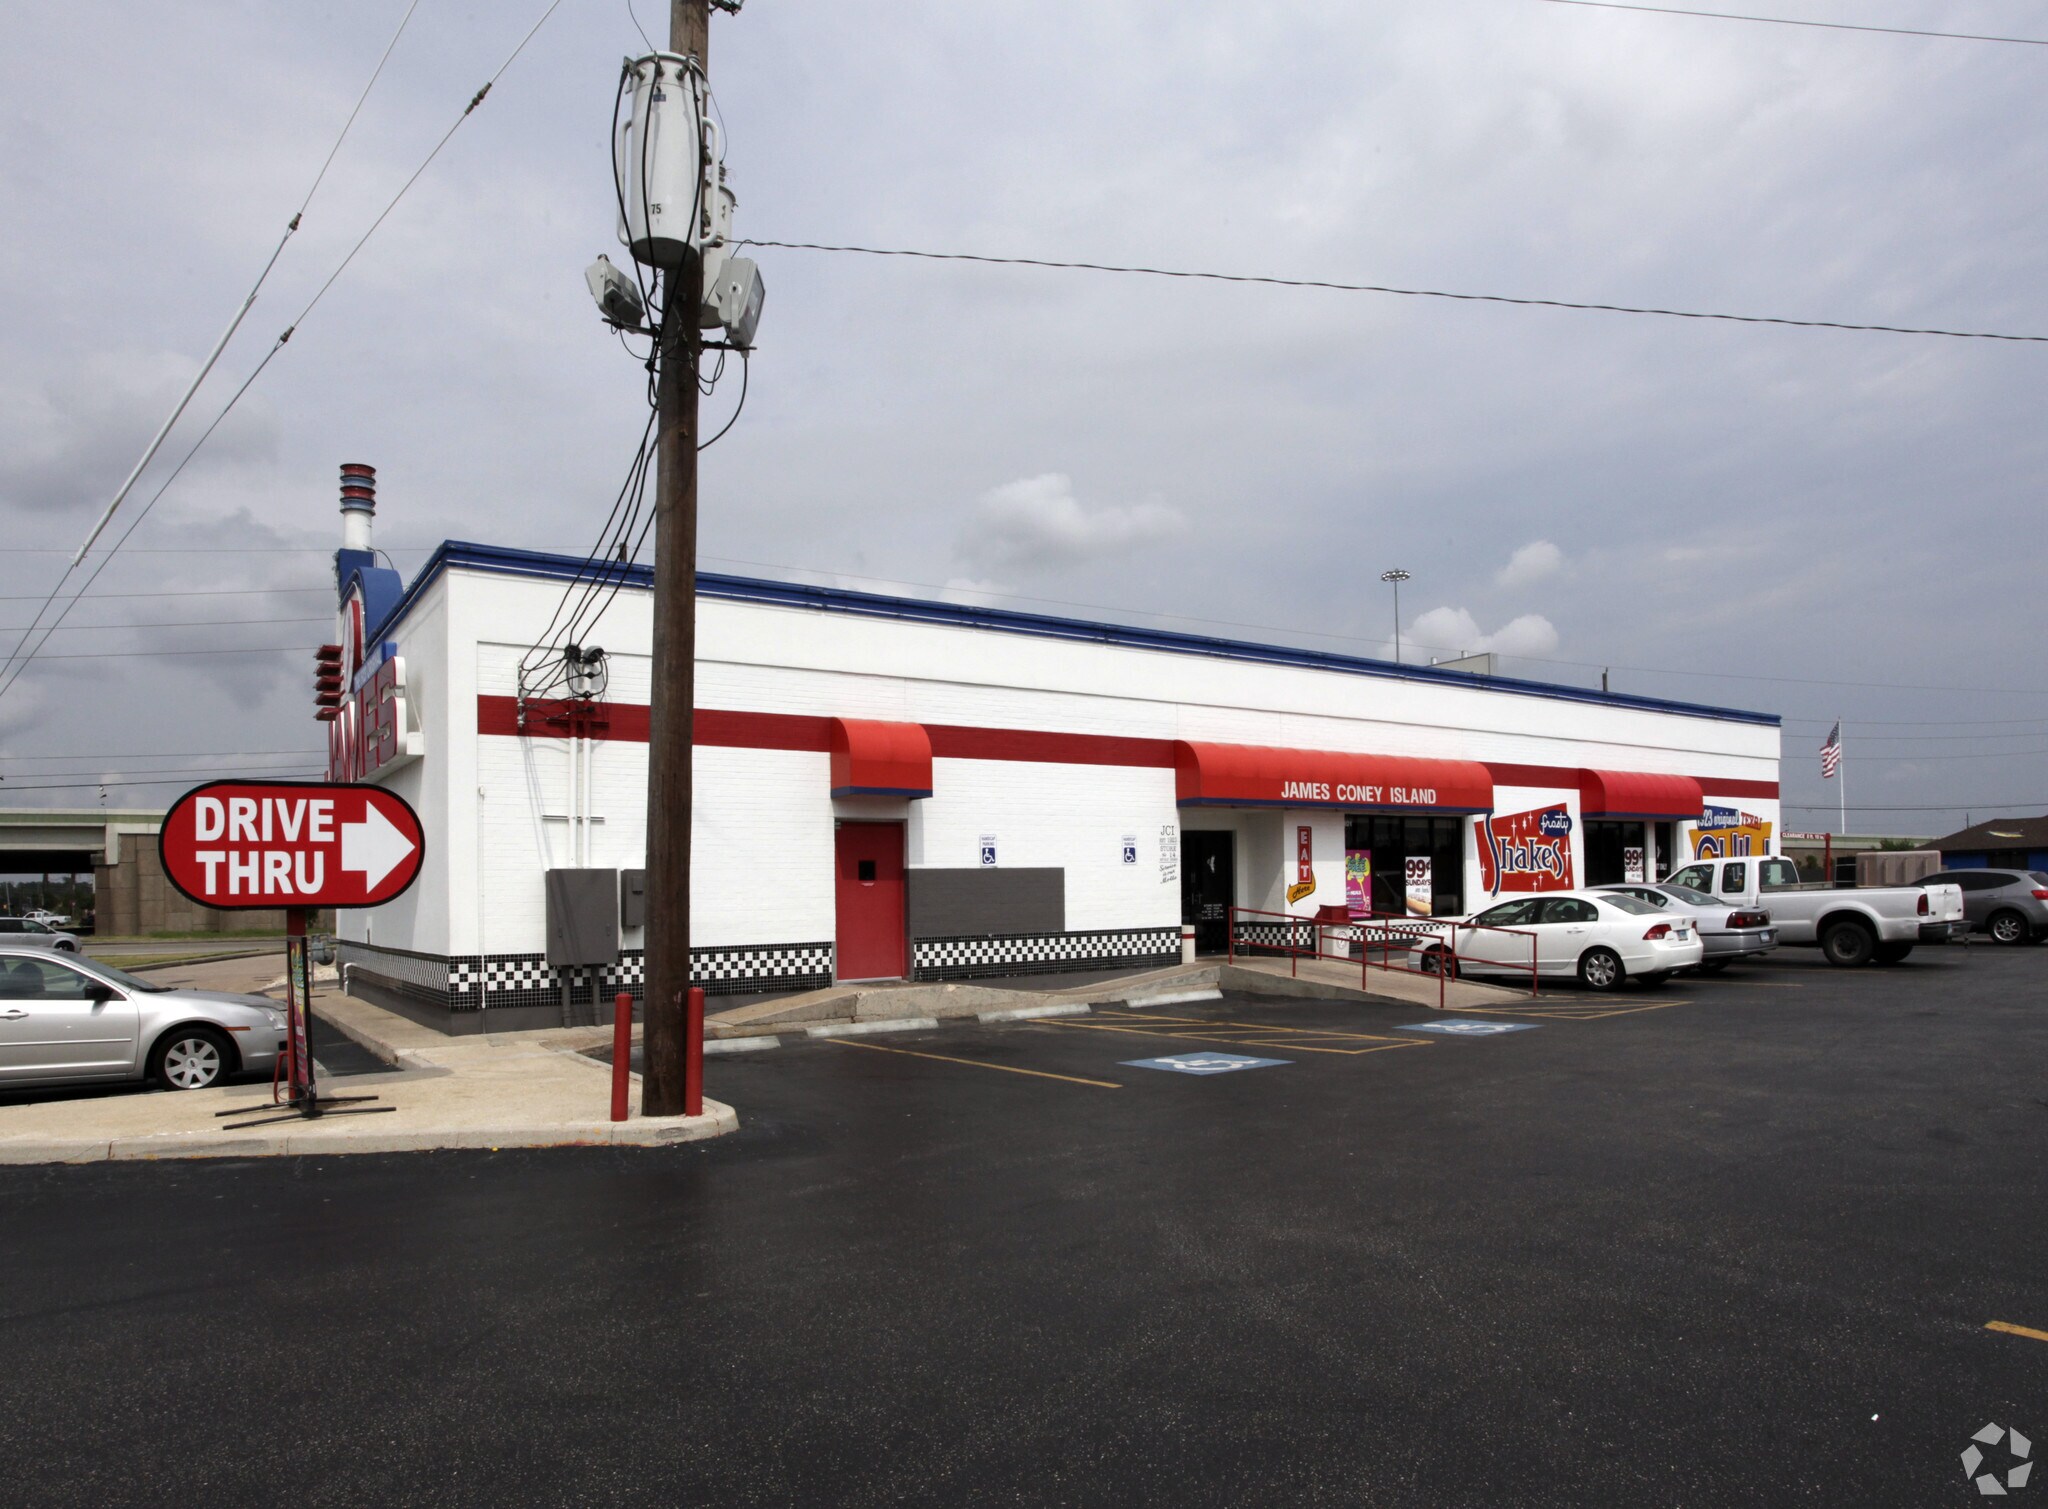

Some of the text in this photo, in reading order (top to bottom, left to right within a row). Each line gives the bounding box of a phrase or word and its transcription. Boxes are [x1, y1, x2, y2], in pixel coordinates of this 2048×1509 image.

[651, 203, 661, 214] 75
[1281, 781, 1437, 804] JAMES CONEY ISLAND
[195, 797, 335, 842] DRIVE
[1160, 825, 1175, 836] JCI
[1539, 811, 1569, 835] frosty
[1713, 811, 1740, 828] original
[1300, 831, 1309, 878] EAT
[1483, 812, 1564, 900] Shakes
[195, 851, 325, 895] THRU
[1406, 859, 1431, 879] 99¢
[1292, 885, 1311, 899] Here
